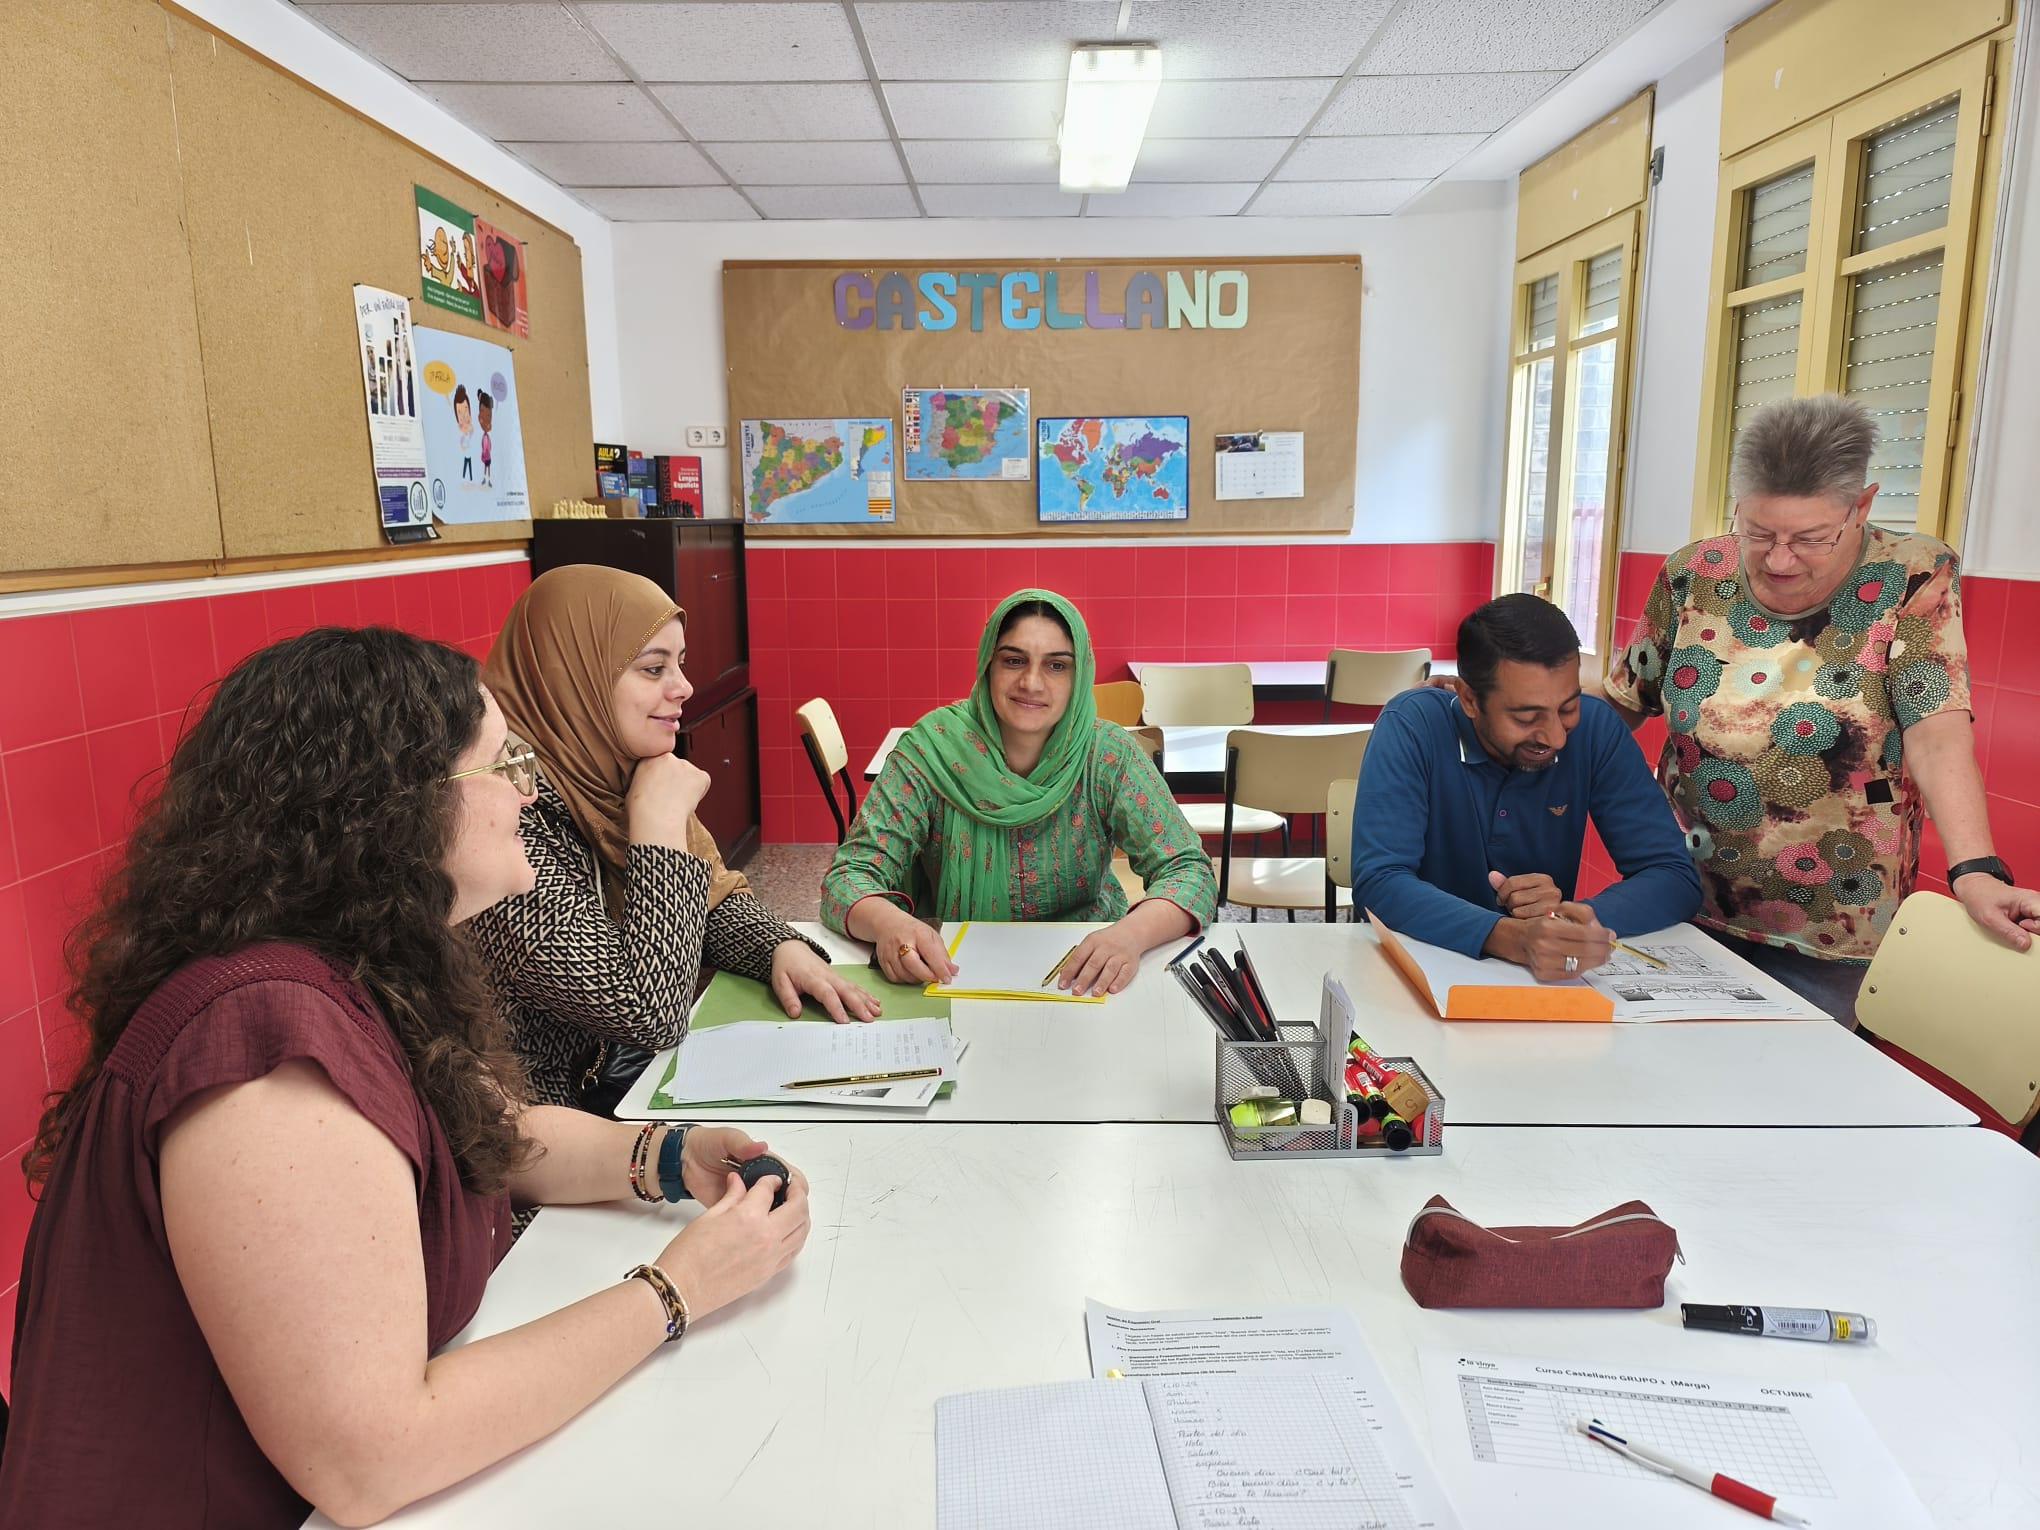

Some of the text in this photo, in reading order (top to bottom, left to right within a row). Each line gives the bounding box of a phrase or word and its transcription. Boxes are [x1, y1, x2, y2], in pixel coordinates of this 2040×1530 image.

[834, 271, 1249, 332] CASTELLANO
[598, 447, 614, 458] AULA
[1535, 1366, 1563, 1375] Curso
[1565, 1370, 1617, 1381] Castellano
[1619, 1375, 1658, 1385] GRUPO
[1670, 1380, 1710, 1390] (Marga)
[1760, 1388, 1813, 1399] OCTUBRE
